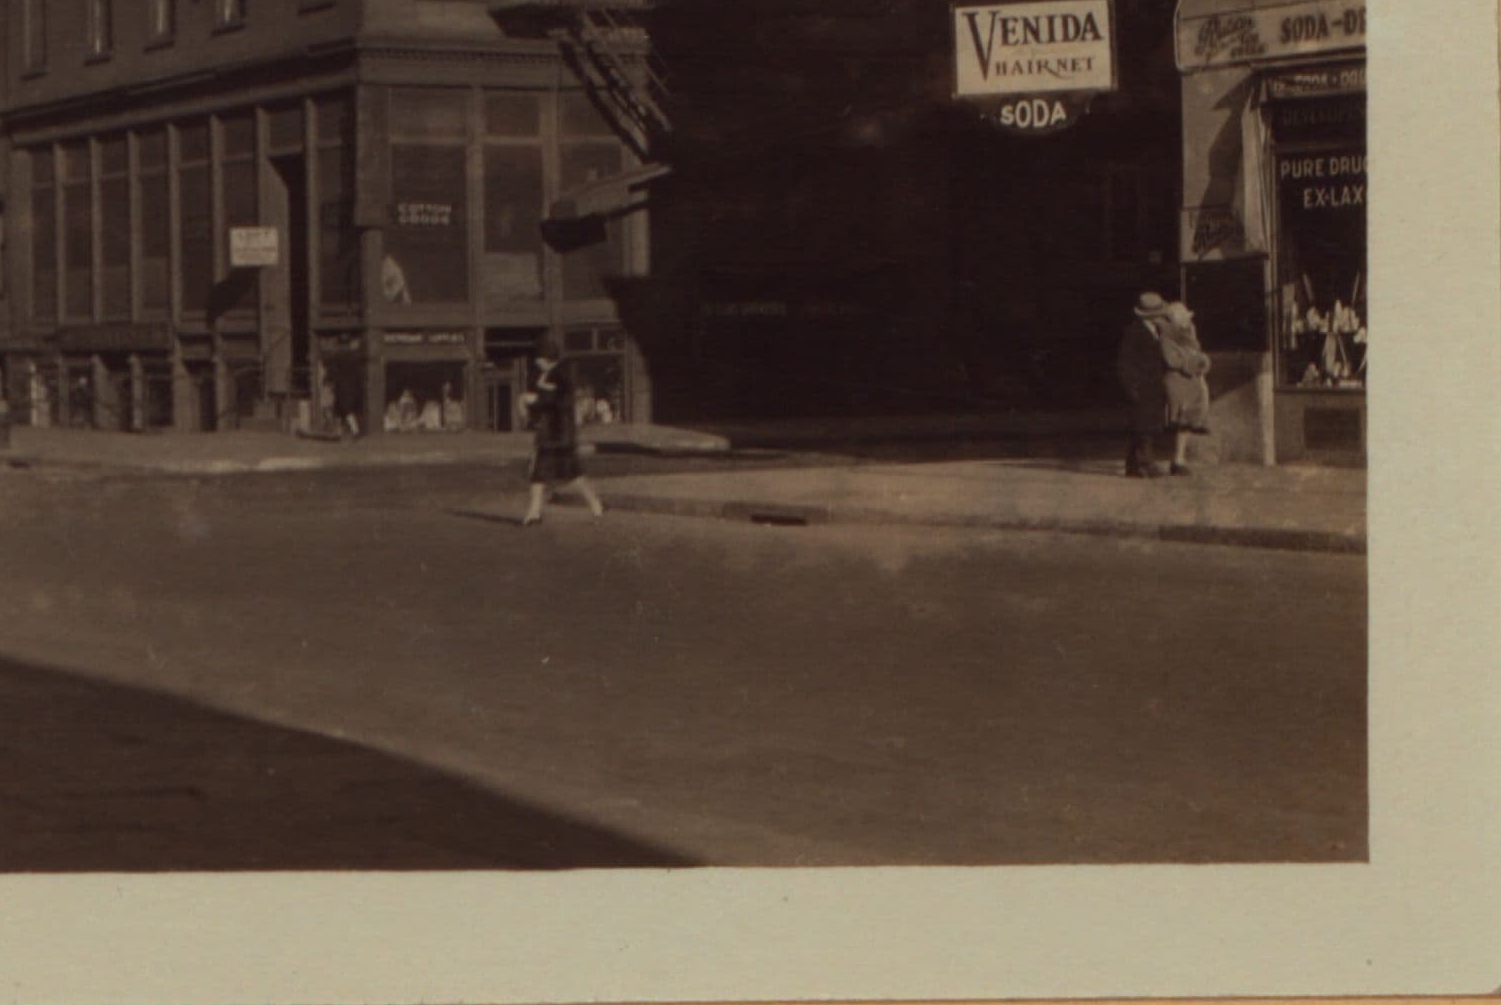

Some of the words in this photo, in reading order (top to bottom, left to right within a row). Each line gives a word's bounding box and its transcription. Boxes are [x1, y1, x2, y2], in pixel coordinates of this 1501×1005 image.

[961, 9, 1105, 82] VENIDA
[1000, 98, 1068, 129] SODA
[1280, 157, 1325, 181] PURE
